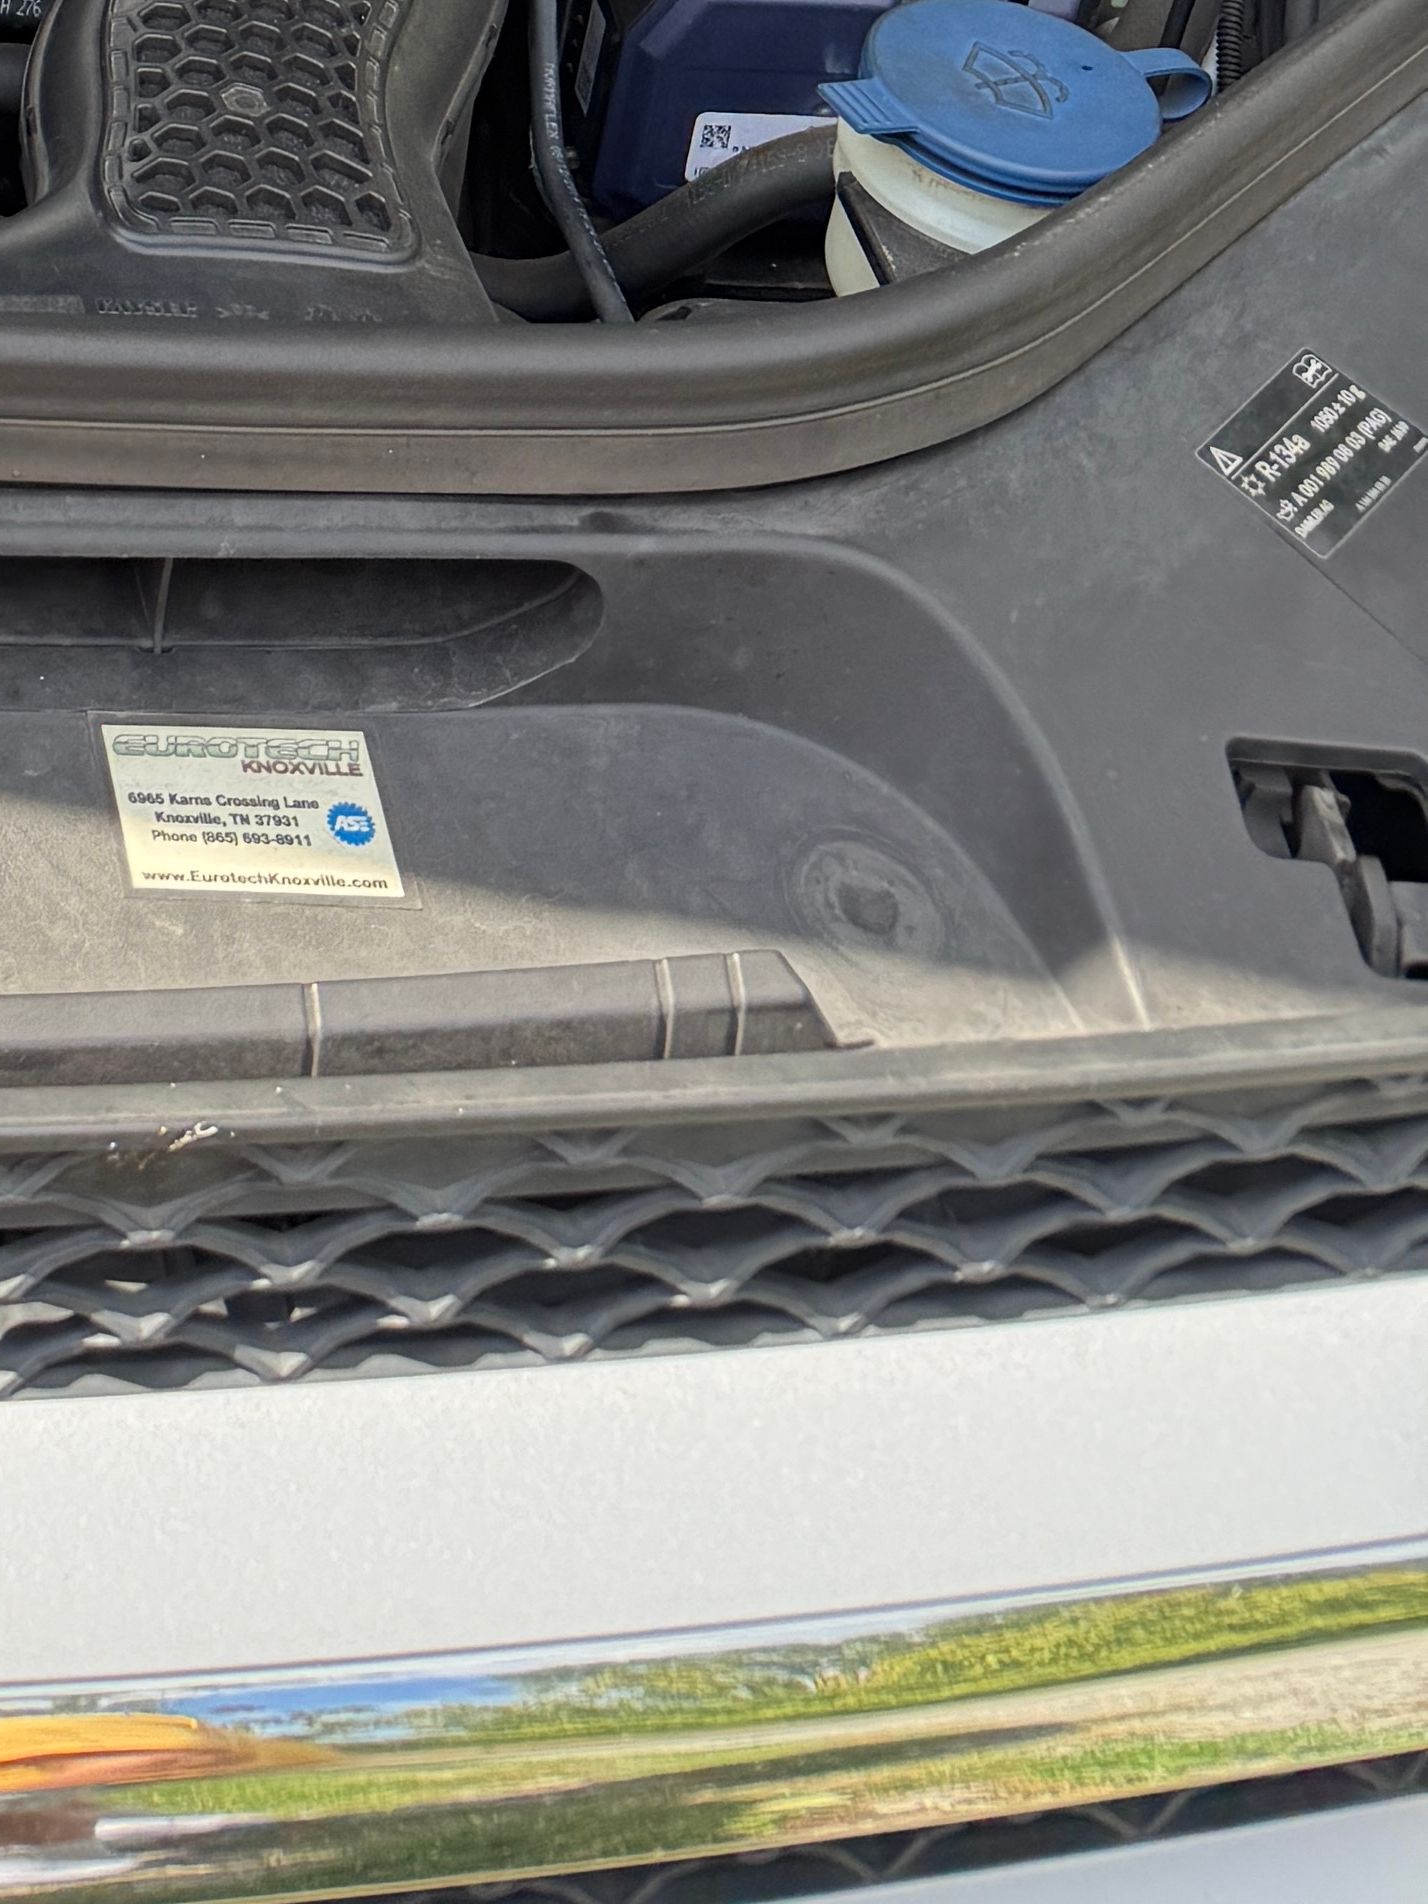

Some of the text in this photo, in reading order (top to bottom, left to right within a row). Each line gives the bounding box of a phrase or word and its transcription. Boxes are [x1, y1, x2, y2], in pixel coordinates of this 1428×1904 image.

[1254, 434, 1311, 482] R-134a
[1311, 407, 1337, 432] 1050
[1298, 475, 1324, 499] 001
[1316, 456, 1340, 480] 989
[1345, 430, 1366, 450] 03
[1357, 407, 1392, 440] (PAG)
[113, 734, 360, 762] EUROTECH
[241, 759, 364, 777] KNOXVILLE
[169, 793, 213, 807] Karns
[216, 795, 280, 811] Crossing
[284, 796, 320, 810] Lane
[154, 811, 299, 828] Knoxville, TN 37931
[335, 815, 370, 833] ASE
[151, 829, 197, 843] Phone
[202, 831, 238, 846] (865)
[142, 870, 389, 889] www.EurotechKnoxville.com
